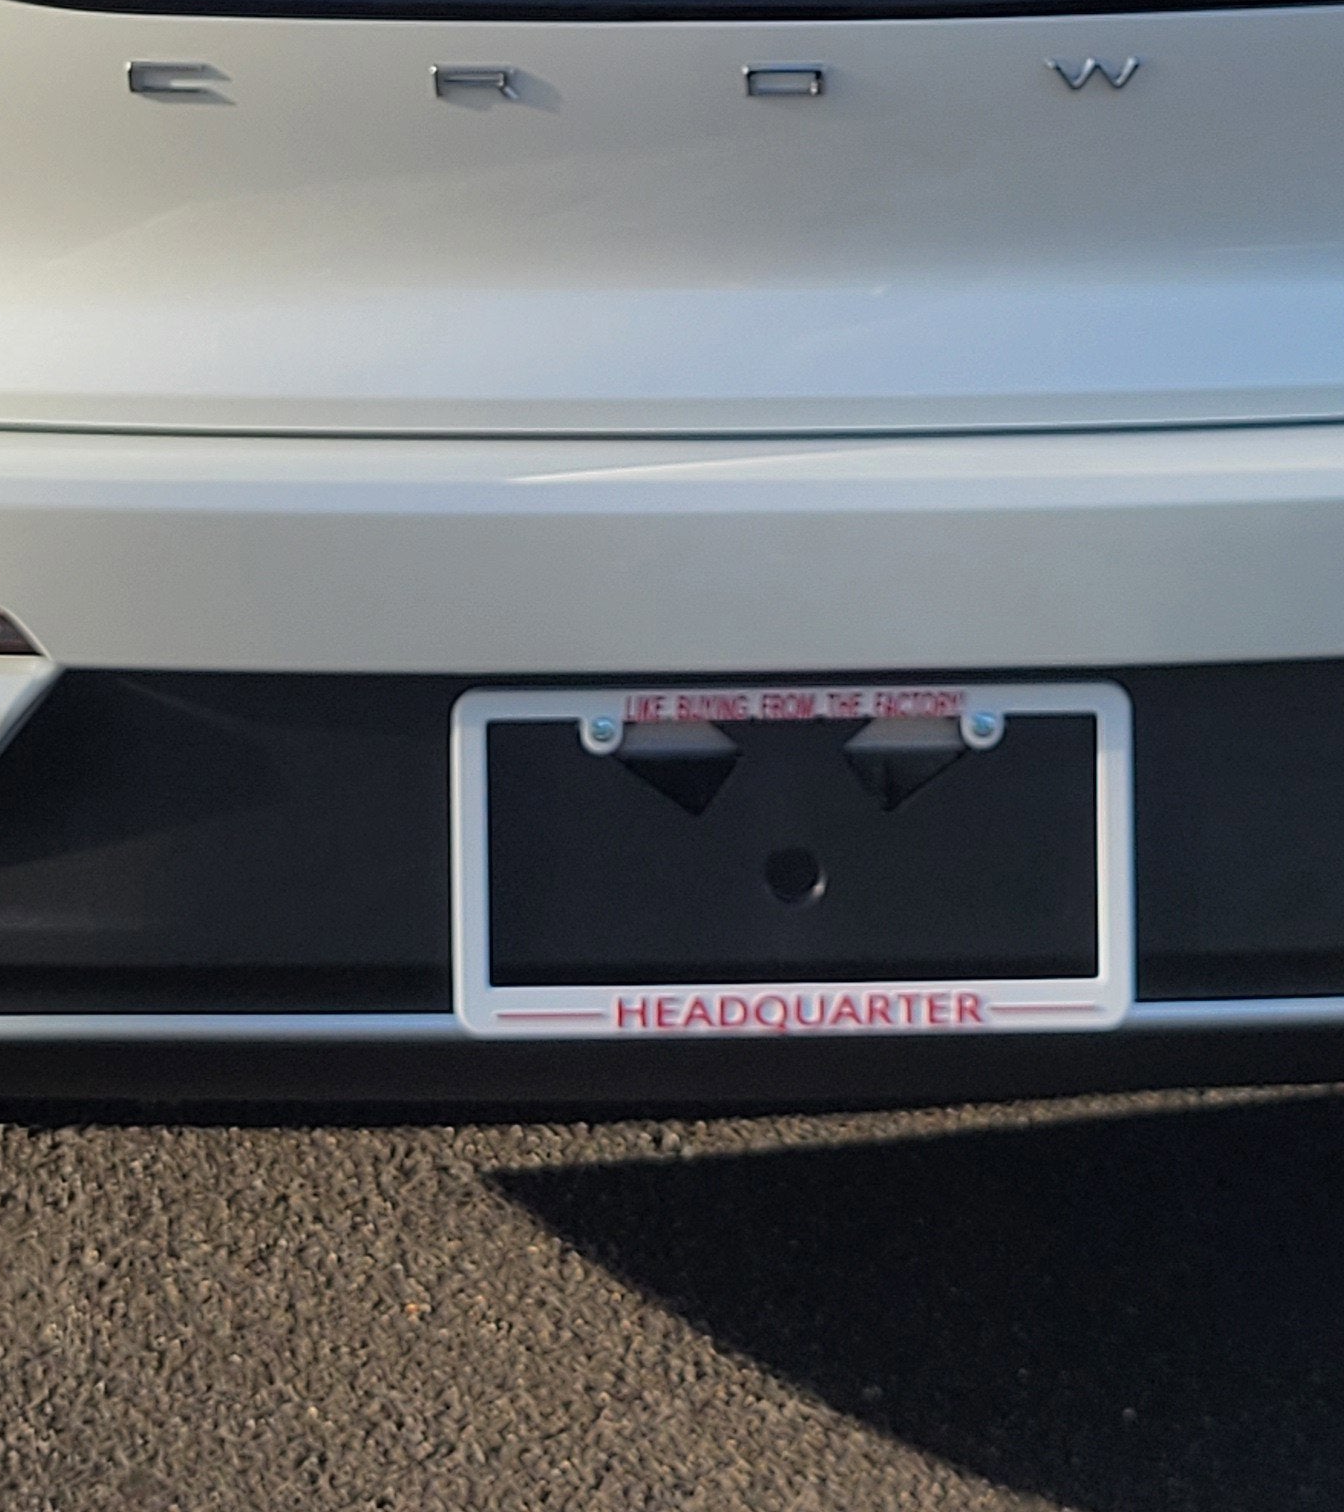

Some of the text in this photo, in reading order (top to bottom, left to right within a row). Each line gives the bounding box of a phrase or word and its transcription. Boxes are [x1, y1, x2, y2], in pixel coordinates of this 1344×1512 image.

[677, 693, 749, 721] BUYING
[762, 692, 815, 719] FROM
[827, 691, 863, 718] THE
[615, 992, 983, 1034] HEADQUARTER
